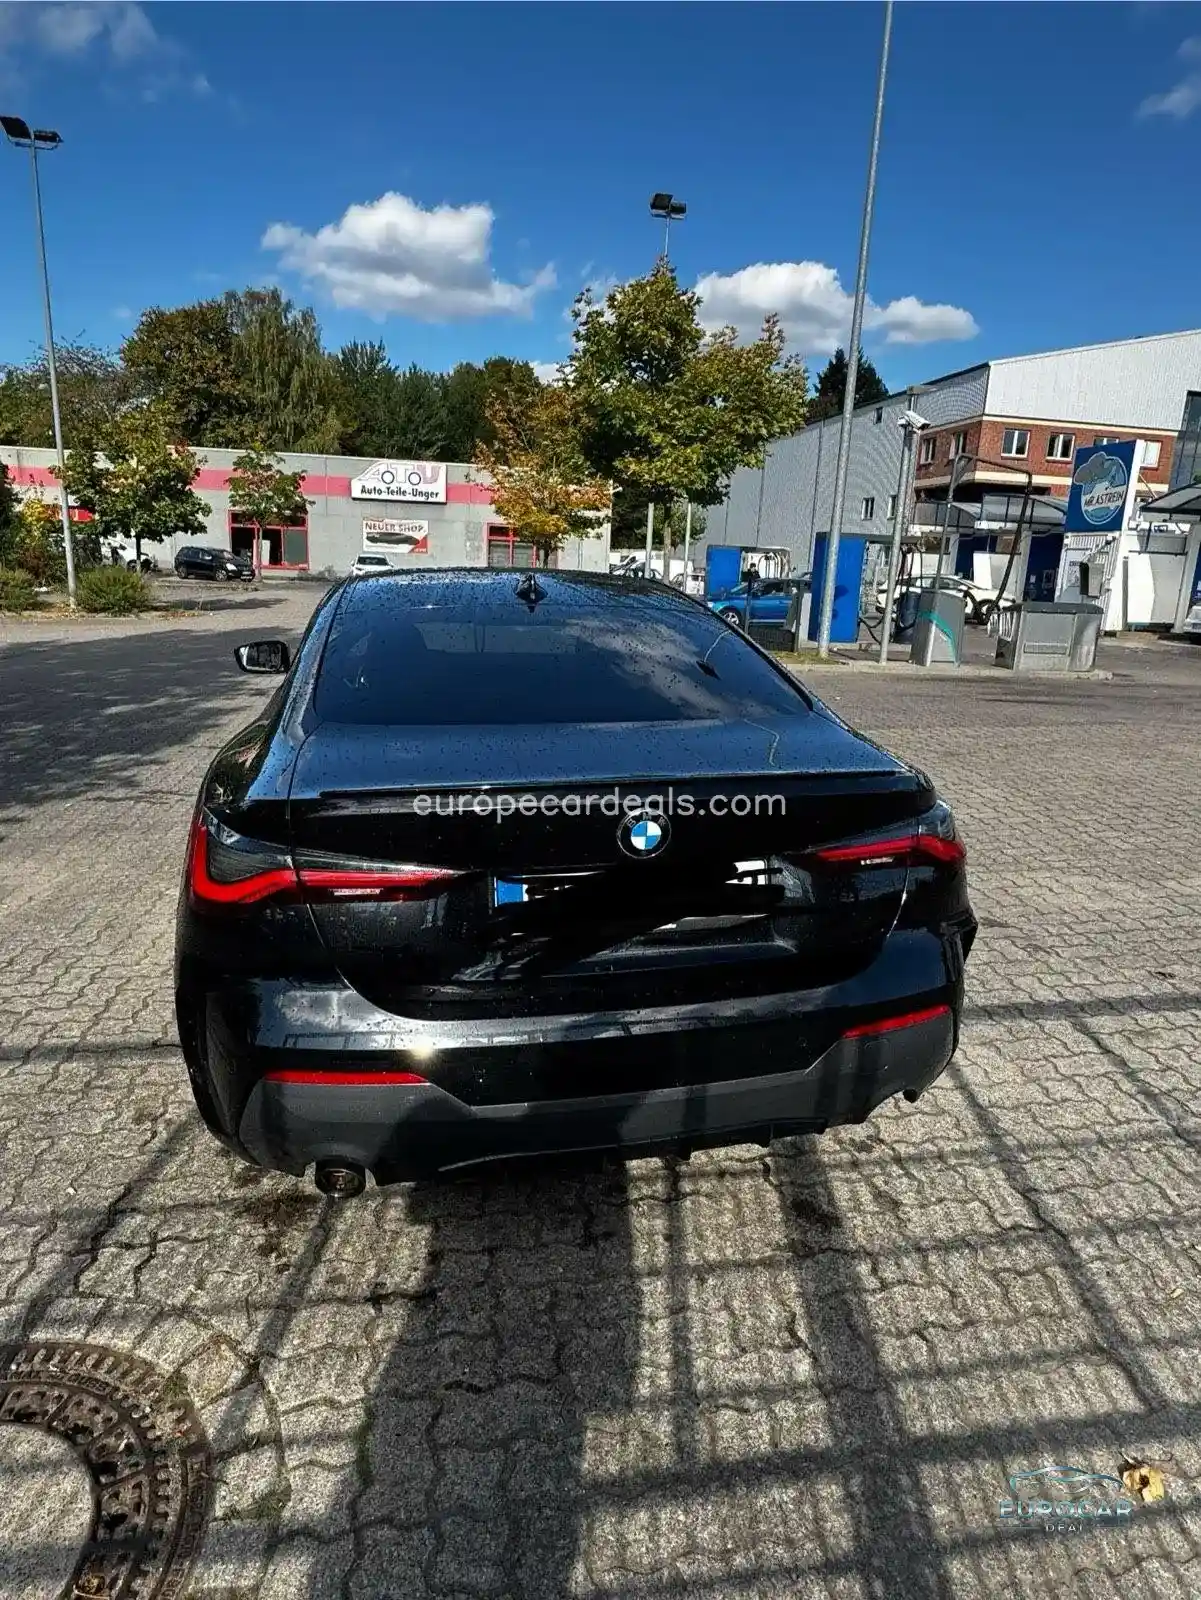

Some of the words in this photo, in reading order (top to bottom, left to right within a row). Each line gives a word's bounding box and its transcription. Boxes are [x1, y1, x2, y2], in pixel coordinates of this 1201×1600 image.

[361, 485, 439, 500] Auto-Teile-Unger
[1096, 490, 1124, 505] ASTREIN
[365, 522, 395, 531] NEUER
